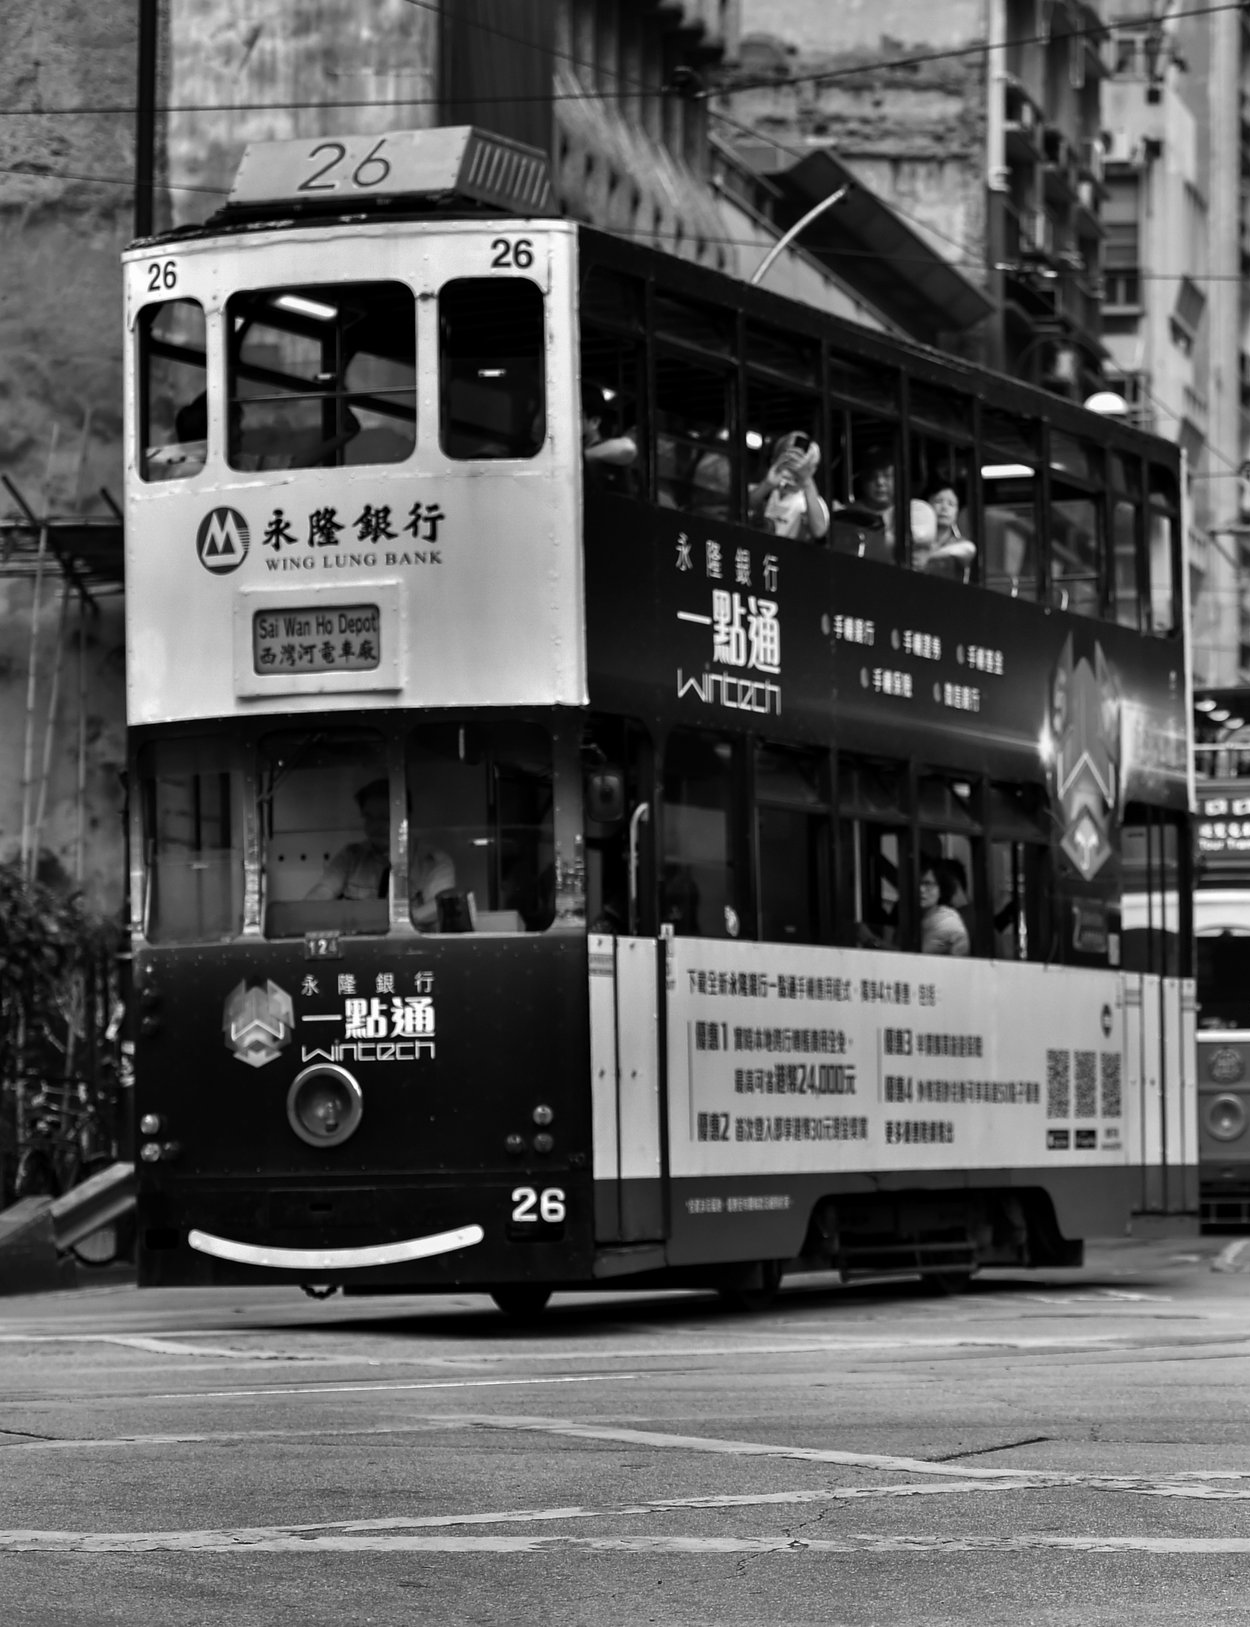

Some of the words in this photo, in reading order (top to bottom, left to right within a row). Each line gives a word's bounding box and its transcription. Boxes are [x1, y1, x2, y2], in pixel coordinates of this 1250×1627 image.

[298, 139, 391, 192] 26
[490, 238, 534, 269] 26
[147, 260, 178, 292] 26
[262, 502, 446, 552] 永隆銀行
[265, 556, 316, 572] WING
[322, 553, 378, 569] LUNG
[385, 549, 443, 566] BANK
[675, 531, 779, 592] 永隆銀行
[259, 618, 280, 639] Sai
[283, 617, 312, 638] Wan
[315, 615, 334, 636] Ho
[338, 613, 377, 636] Depot
[676, 588, 782, 675] 一點通
[259, 637, 378, 667] 西灣河電車廠
[301, 971, 435, 995] 永隆銀行
[301, 996, 436, 1039] 一點通
[511, 1186, 566, 1222] 26
